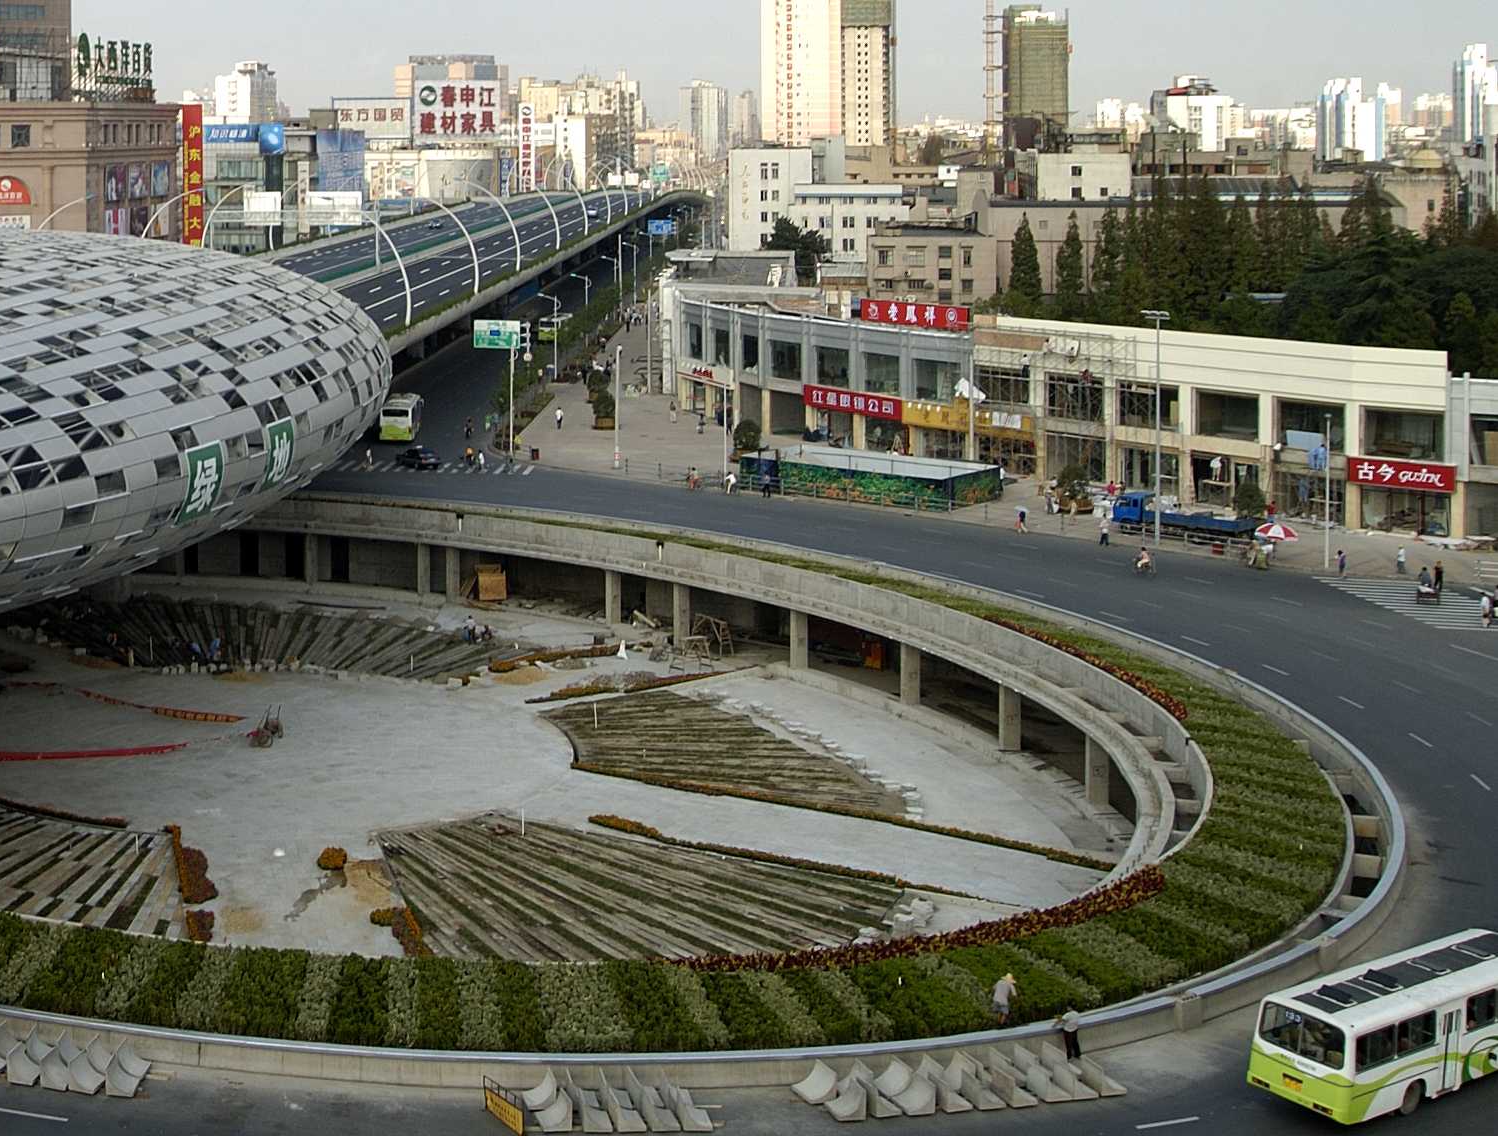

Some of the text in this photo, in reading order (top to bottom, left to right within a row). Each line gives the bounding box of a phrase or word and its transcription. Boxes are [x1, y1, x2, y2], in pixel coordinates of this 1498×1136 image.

[94, 36, 153, 74] 大西洋百货
[441, 85, 495, 107] 春申江
[340, 108, 404, 122] 东方国贸
[420, 112, 496, 135] 建材家具
[1356, 462, 1395, 482] 古今
